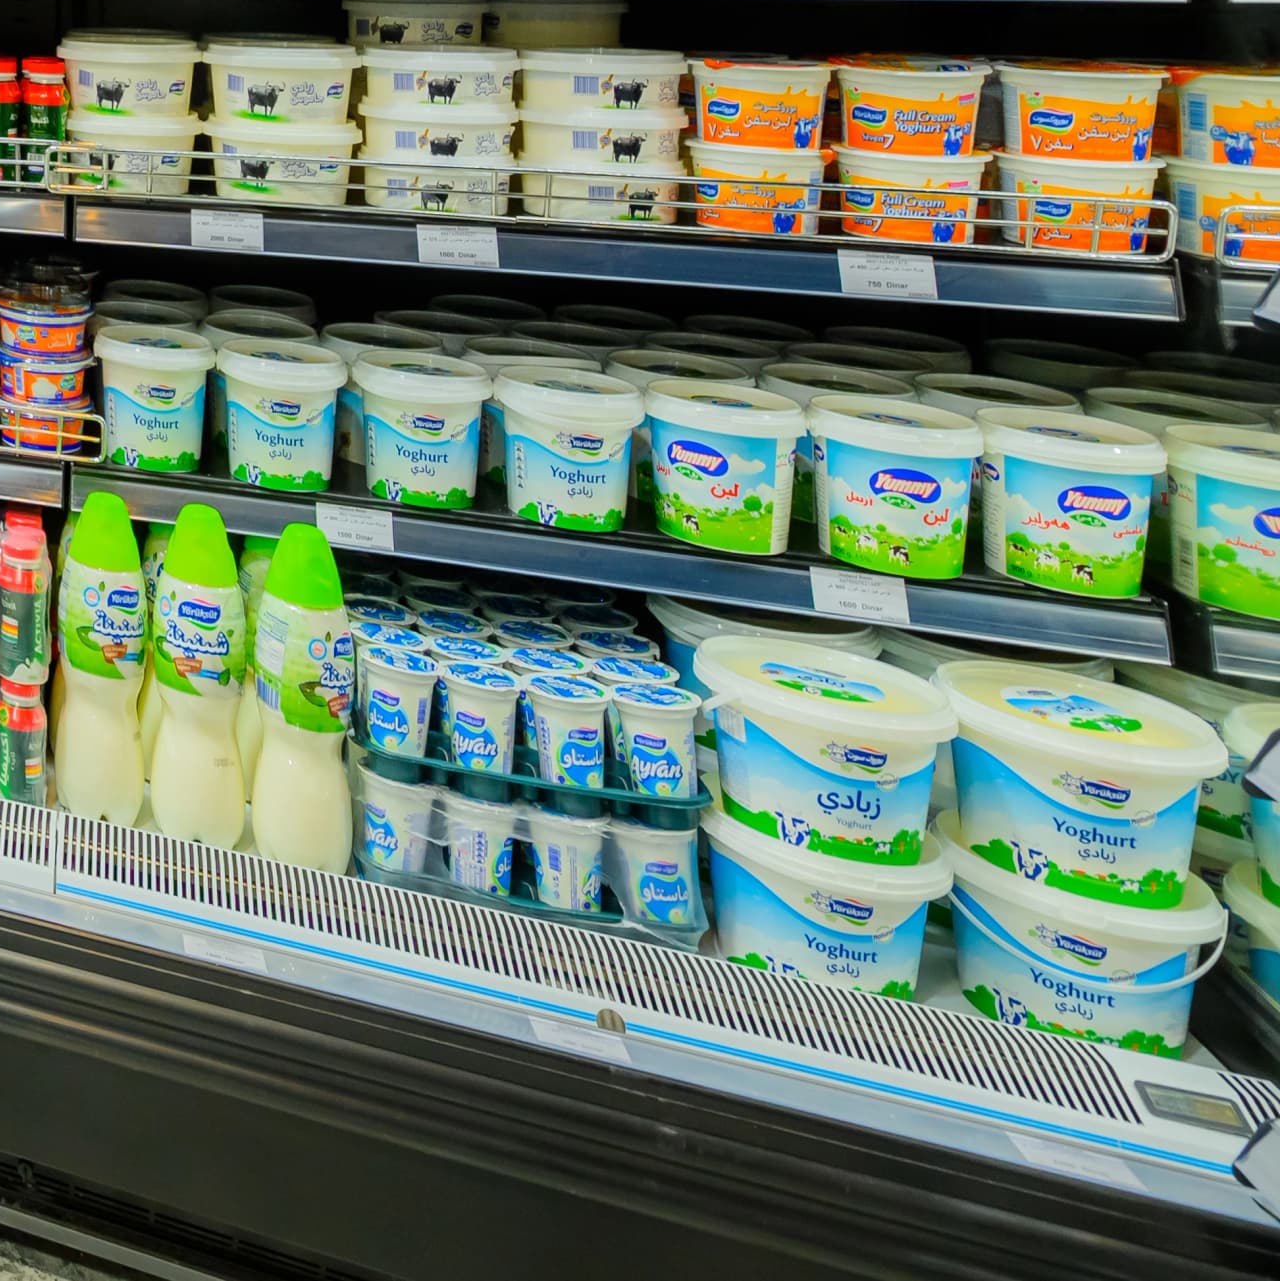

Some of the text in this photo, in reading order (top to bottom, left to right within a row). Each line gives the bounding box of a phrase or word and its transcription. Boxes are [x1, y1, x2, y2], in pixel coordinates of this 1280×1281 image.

[744, 115, 790, 128] لبن سفن
[894, 110, 956, 122] Full Cream
[894, 121, 941, 134] Yoghurt
[1077, 127, 1130, 141] لبن سفن
[883, 134, 895, 148] 7
[881, 194, 944, 208] Full Cream
[133, 414, 179, 431] Yoghurt
[146, 432, 168, 443] زبادي
[255, 428, 305, 447] Yoghurt
[269, 450, 292, 461] زبادي
[395, 444, 448, 464] Yoghurt
[670, 444, 723, 471] Yummy
[411, 464, 435, 477] زبادي
[550, 465, 606, 485] Yoghurt
[567, 485, 593, 498] زبادي
[710, 483, 739, 499] لبن
[874, 472, 938, 498] Yummy
[1064, 489, 1128, 516] Yummy
[923, 508, 950, 526] لبن
[182, 604, 217, 620] Yörüksüt
[34, 599, 43, 654] ACTIVIA
[453, 732, 498, 758] Ayran
[631, 756, 683, 779] Ayran
[817, 787, 882, 820] زبادي
[836, 818, 872, 832] Yoghurt
[1052, 817, 1137, 849] Yoghurt
[1078, 848, 1116, 864] زبادي
[804, 934, 878, 964] Yoghurt
[827, 962, 861, 978] زبادي
[1029, 968, 1116, 1008] Yoghurt
[1055, 1000, 1094, 1020] زبادي
